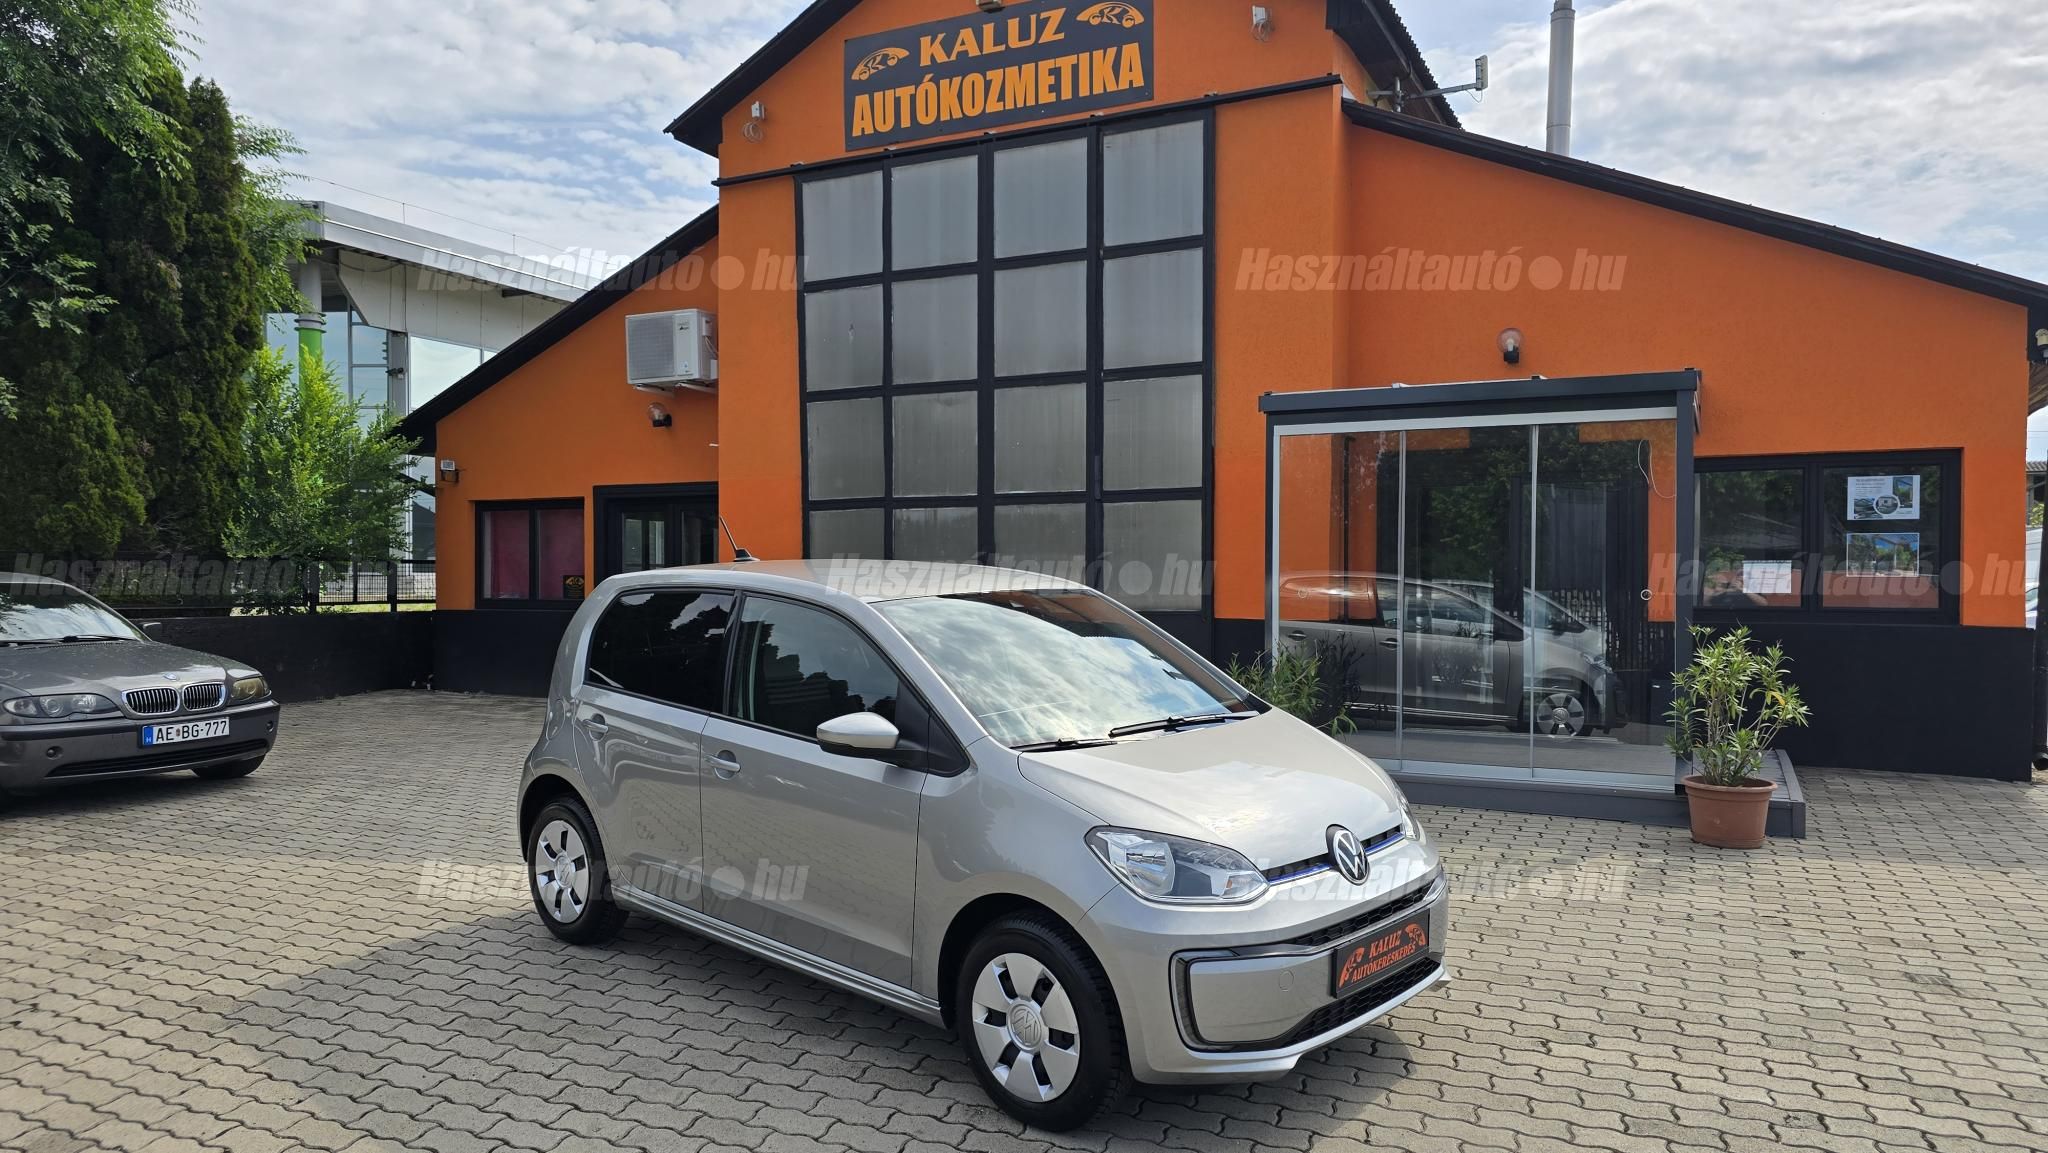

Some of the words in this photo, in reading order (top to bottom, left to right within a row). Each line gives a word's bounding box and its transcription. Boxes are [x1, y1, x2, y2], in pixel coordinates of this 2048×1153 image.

[920, 7, 1067, 67] KALUZ
[851, 42, 1145, 137] AUTÓKOZMETIKA
[156, 727, 174, 742] AE
[182, 721, 227, 739] BG-777
[1369, 930, 1402, 958] KALUZ
